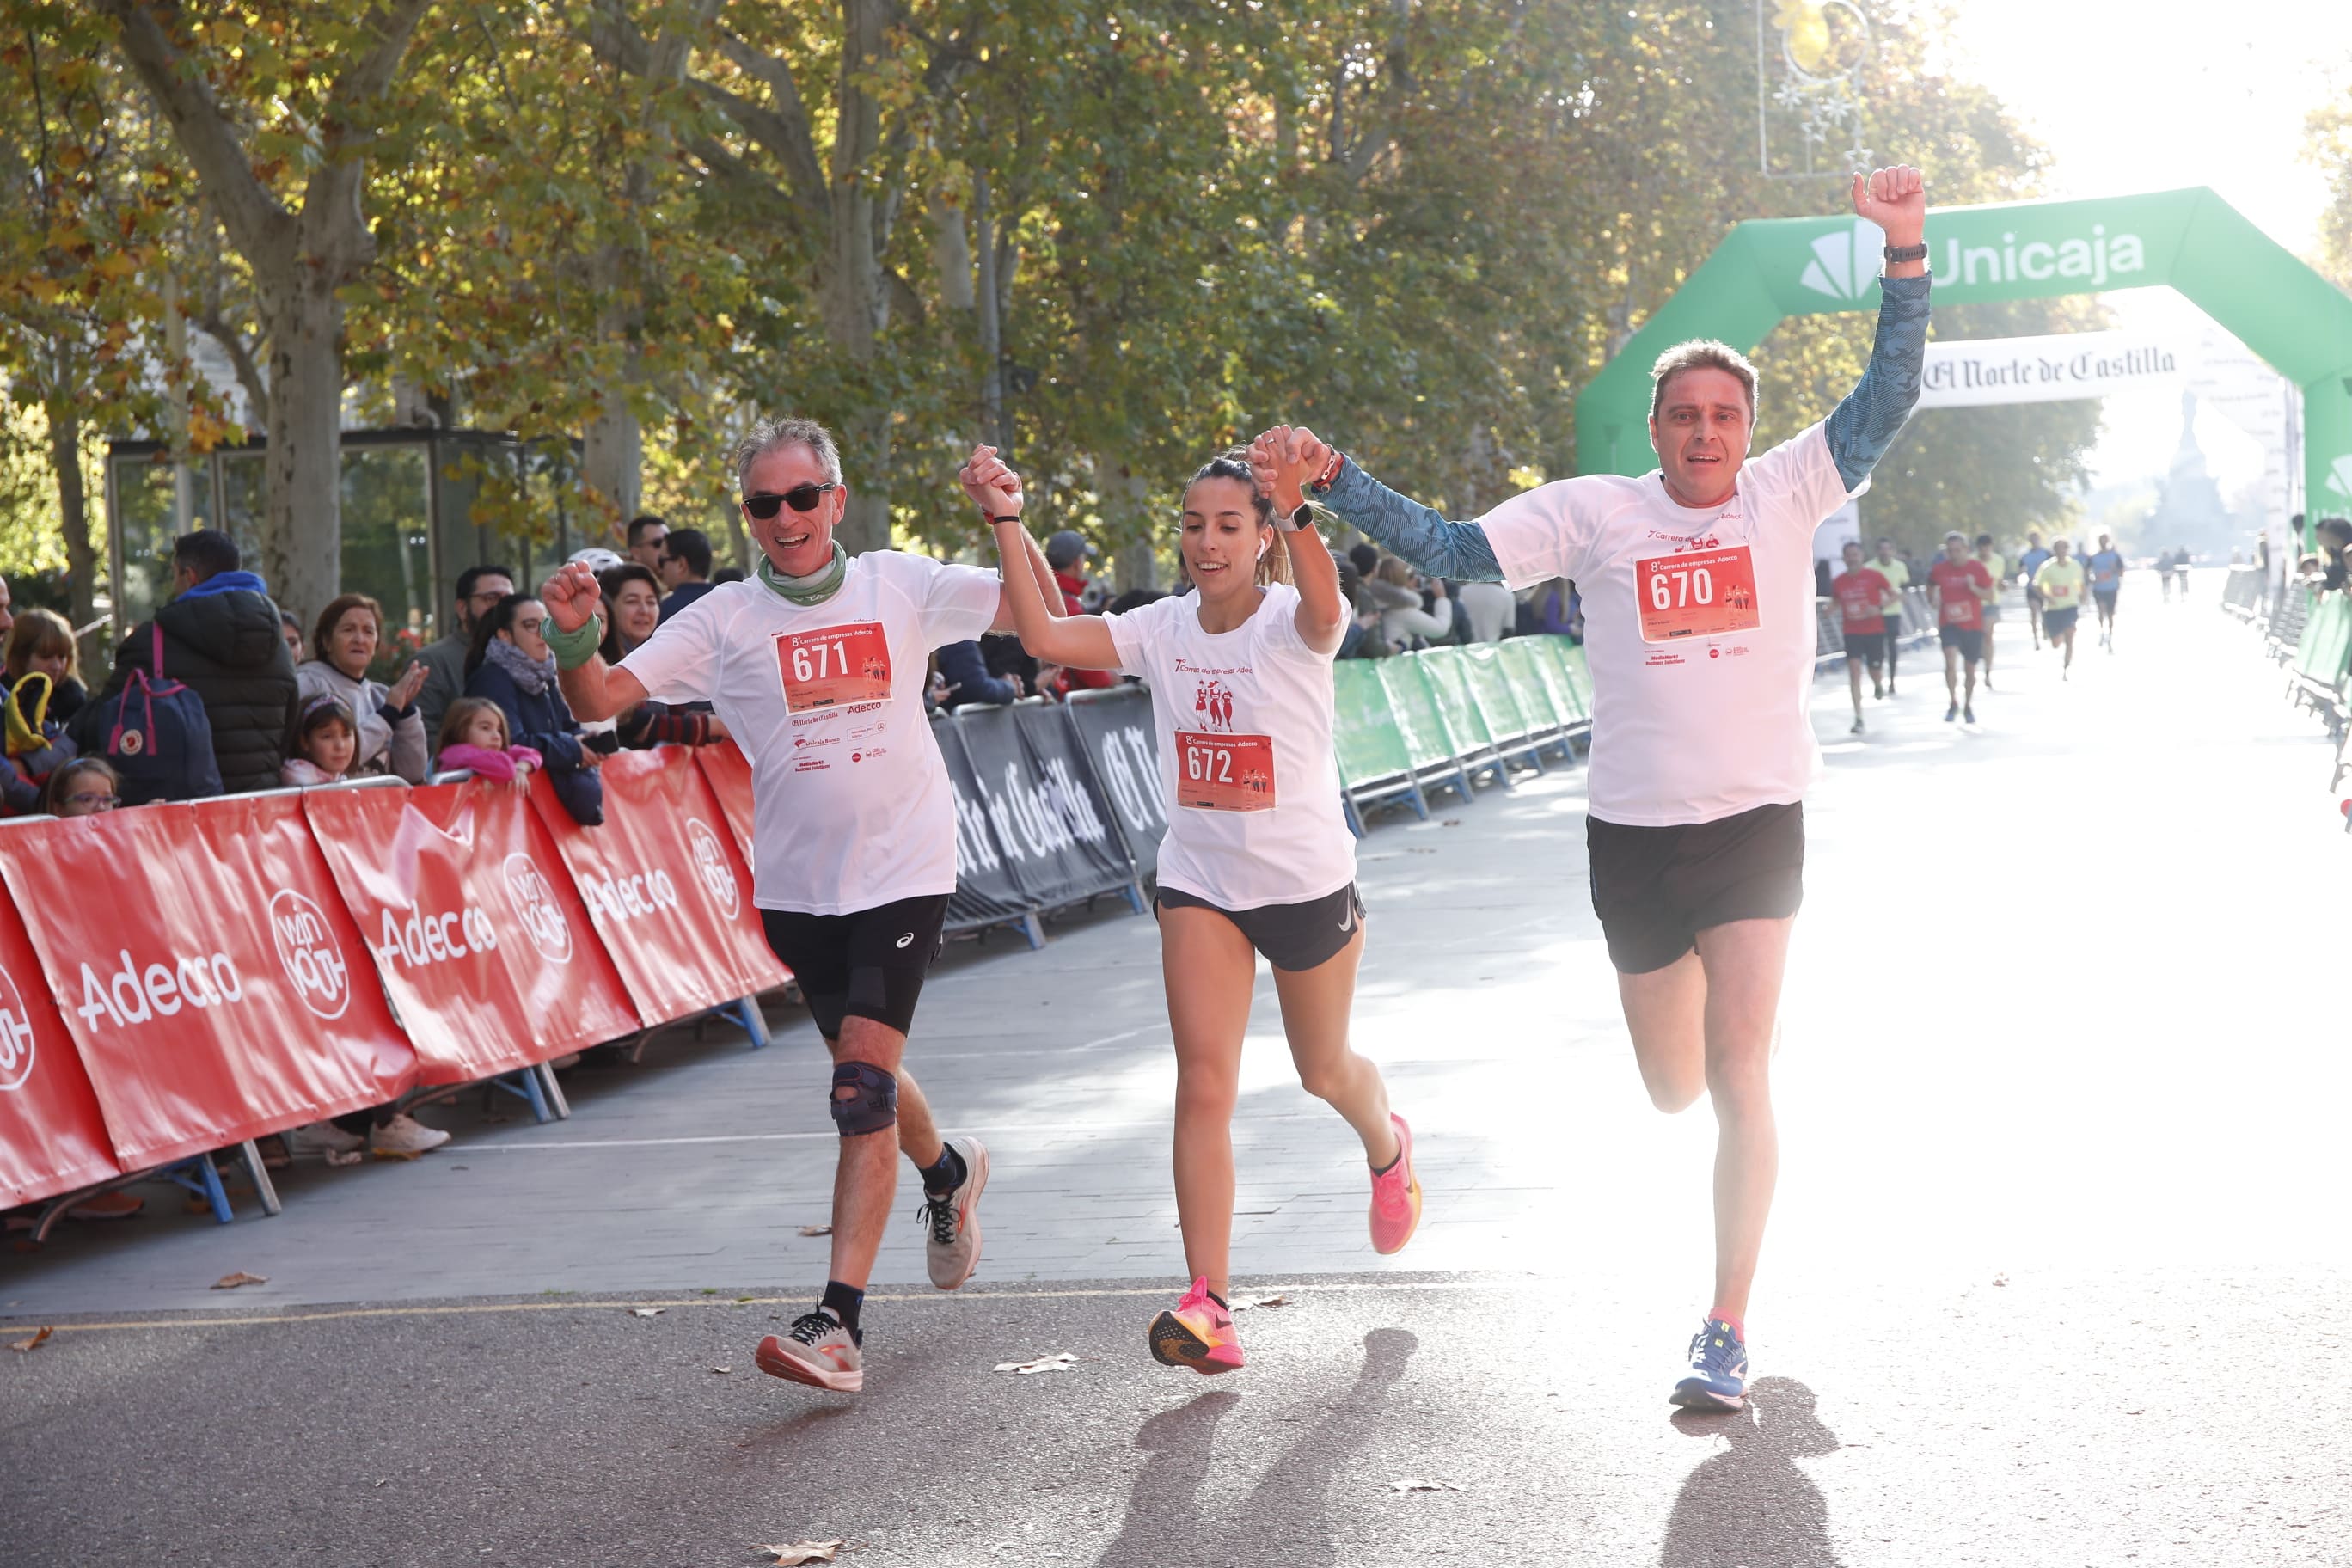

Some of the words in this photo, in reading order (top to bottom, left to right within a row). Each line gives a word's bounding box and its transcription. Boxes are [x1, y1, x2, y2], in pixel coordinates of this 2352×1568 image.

[1931, 223, 2146, 288] Unicaja
[1923, 361, 1956, 390] El
[1962, 358, 2034, 389] Norte
[2037, 357, 2065, 383] de
[2070, 346, 2177, 382] Castilla
[1656, 531, 1683, 542] Carrera
[1659, 562, 1681, 571] Carrera
[1688, 559, 1716, 568] empresas
[1651, 568, 1713, 610] 670
[827, 632, 853, 640] empresas
[792, 640, 848, 682] 671
[799, 718, 813, 726] Norte
[818, 711, 839, 722] Castilla
[847, 701, 882, 715] Adecco
[1187, 746, 1234, 783] 672
[583, 866, 677, 927] Adecco
[378, 898, 498, 971] Adecco
[77, 949, 242, 1032] Adecco
